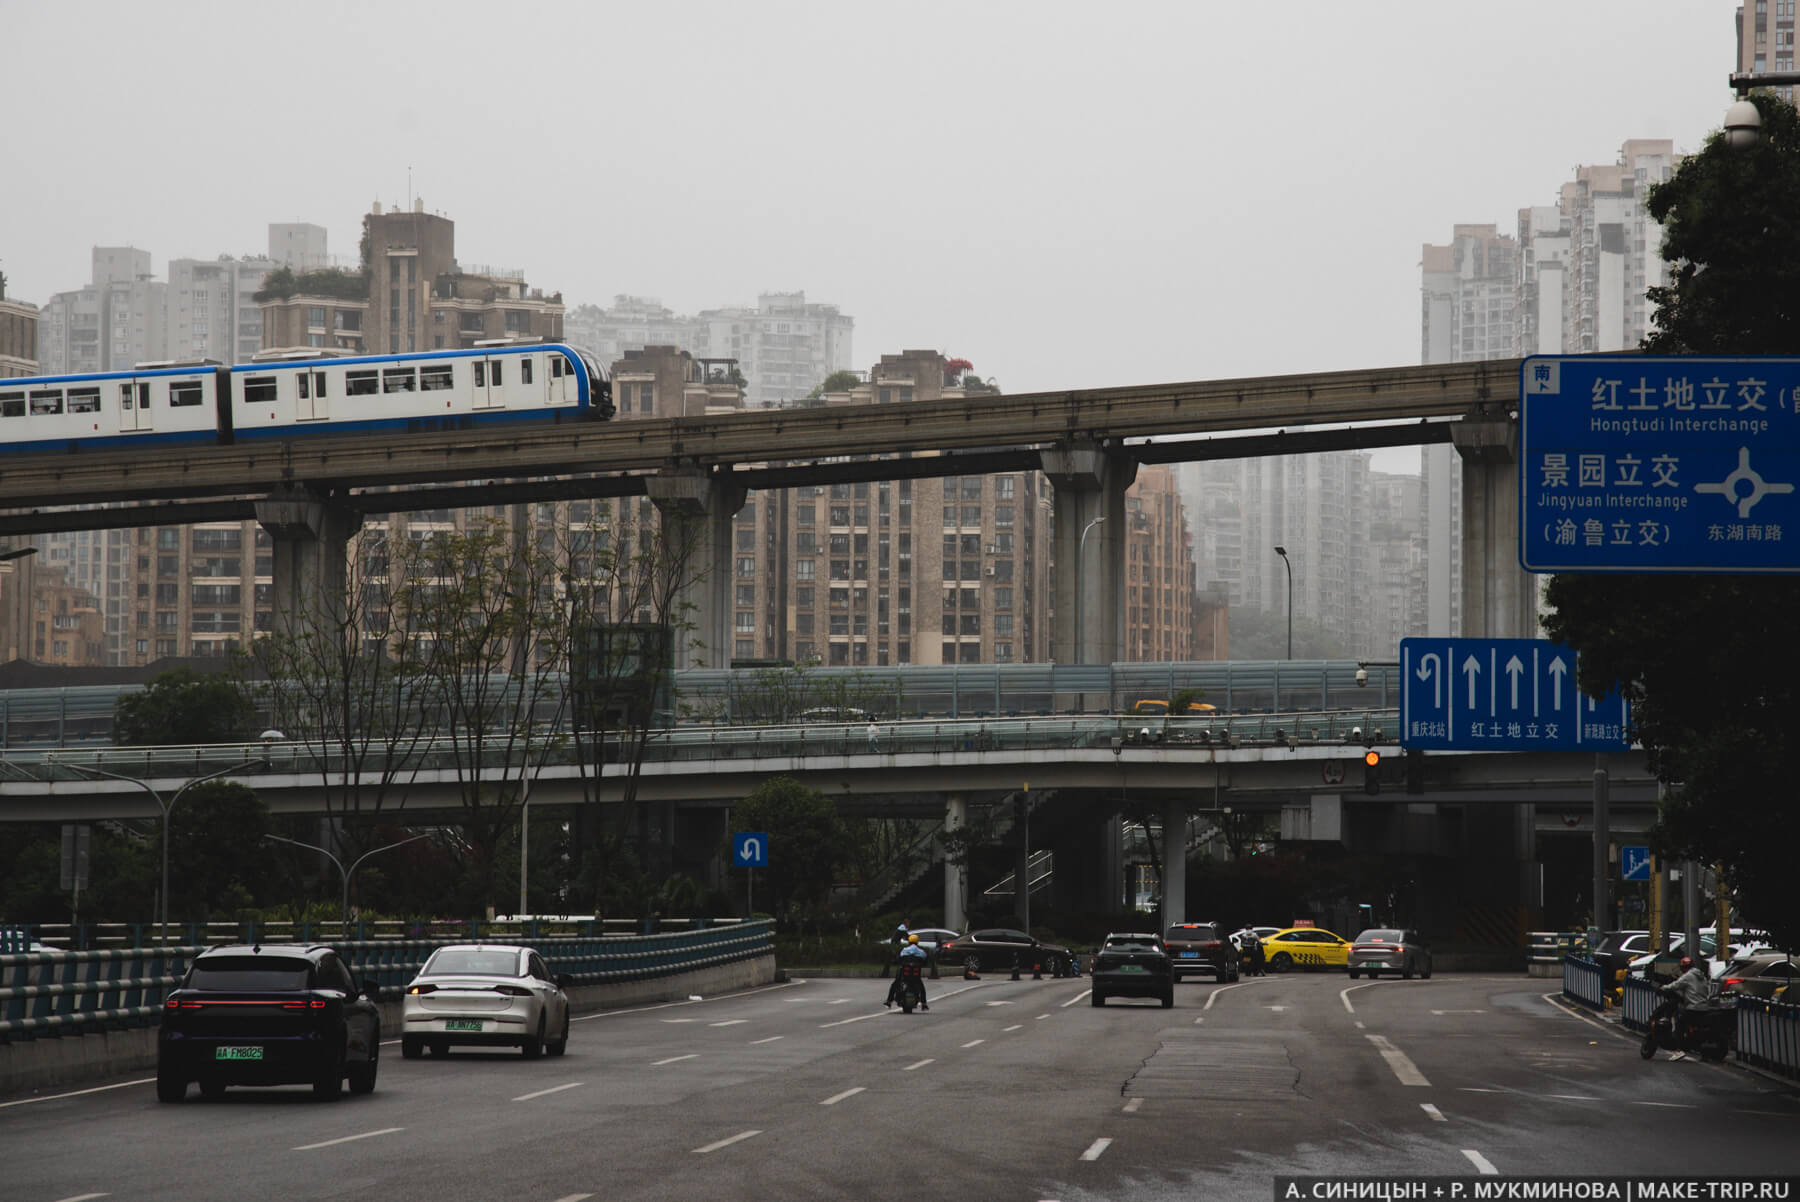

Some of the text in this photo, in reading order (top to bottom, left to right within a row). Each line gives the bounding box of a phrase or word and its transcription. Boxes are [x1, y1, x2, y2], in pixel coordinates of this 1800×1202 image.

[1534, 364, 1551, 381] 南
[1591, 376, 1768, 412] 红土地立交
[1590, 417, 1769, 436] Hongtudi Interchange
[1540, 453, 1681, 488] 景园立交
[1537, 492, 1688, 511] Jingyuan Interchange
[1707, 523, 1784, 542] 东湖南路
[1411, 721, 1446, 737] 重庆北站
[1471, 721, 1560, 739] 红土地立交
